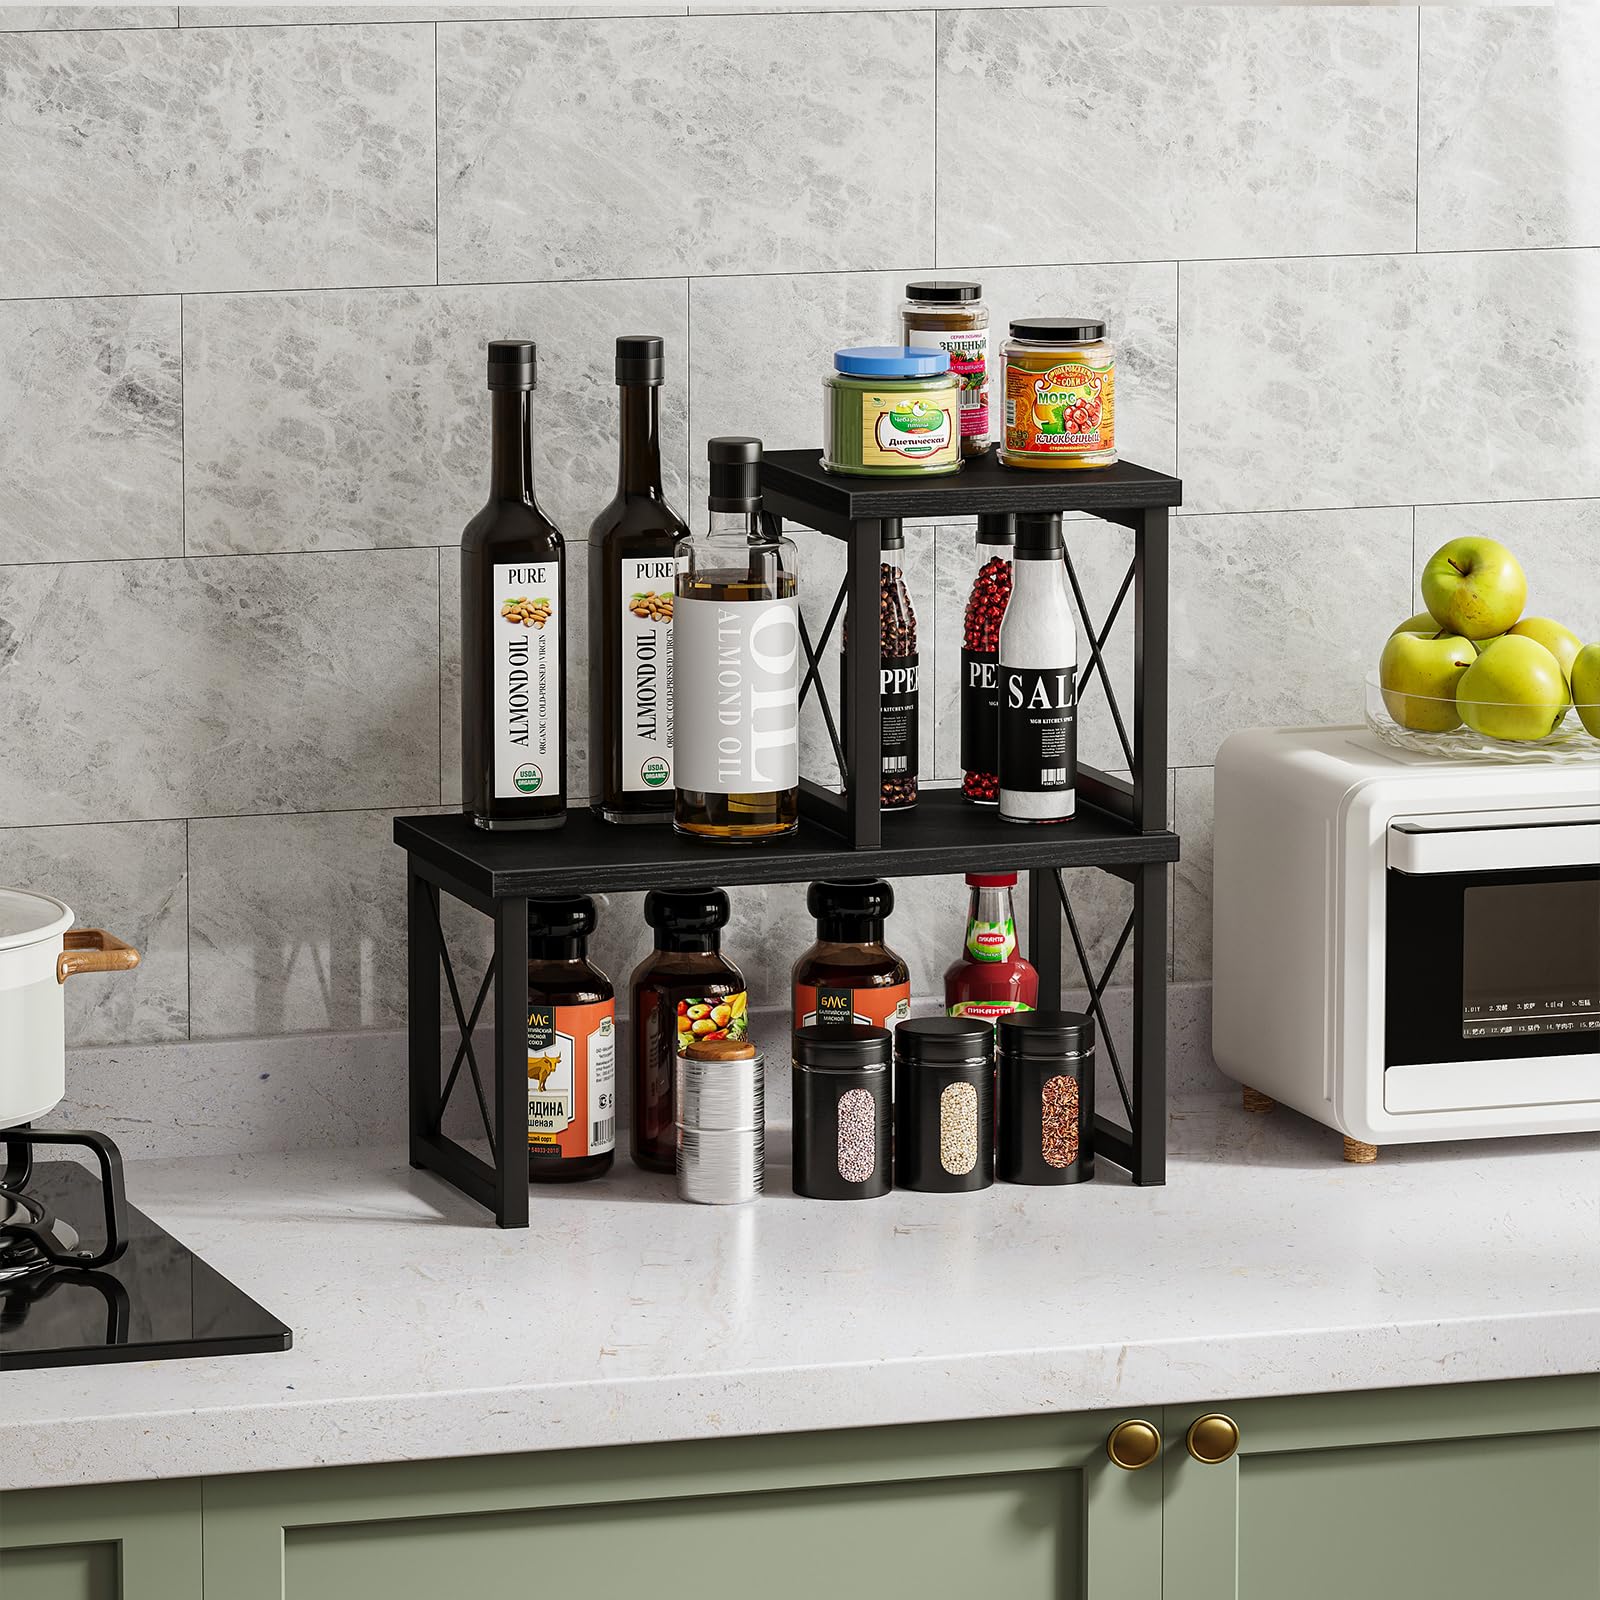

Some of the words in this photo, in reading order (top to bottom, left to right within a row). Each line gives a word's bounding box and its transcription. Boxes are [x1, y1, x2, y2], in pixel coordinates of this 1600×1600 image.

[939, 337, 987, 351] ЗЕЛЕНЫЙ
[1062, 378, 1081, 387] СОКИ
[1038, 392, 1076, 404] МОРС
[888, 438, 945, 446] Диетическая
[508, 567, 547, 585] PURE
[636, 562, 674, 579] PURE
[508, 634, 529, 667] OIL
[538, 634, 547, 661] VIRGIN
[636, 628, 657, 661] OIL
[718, 607, 742, 727] ALMOND
[969, 661, 999, 689] PE
[636, 663, 657, 742] ALMOND
[749, 604, 798, 783] OIL
[508, 668, 529, 747] ALMOND
[538, 721, 547, 755] ORGANIC
[647, 764, 664, 772] USDA
[718, 736, 742, 784] OIL
[520, 770, 537, 778] USDA
